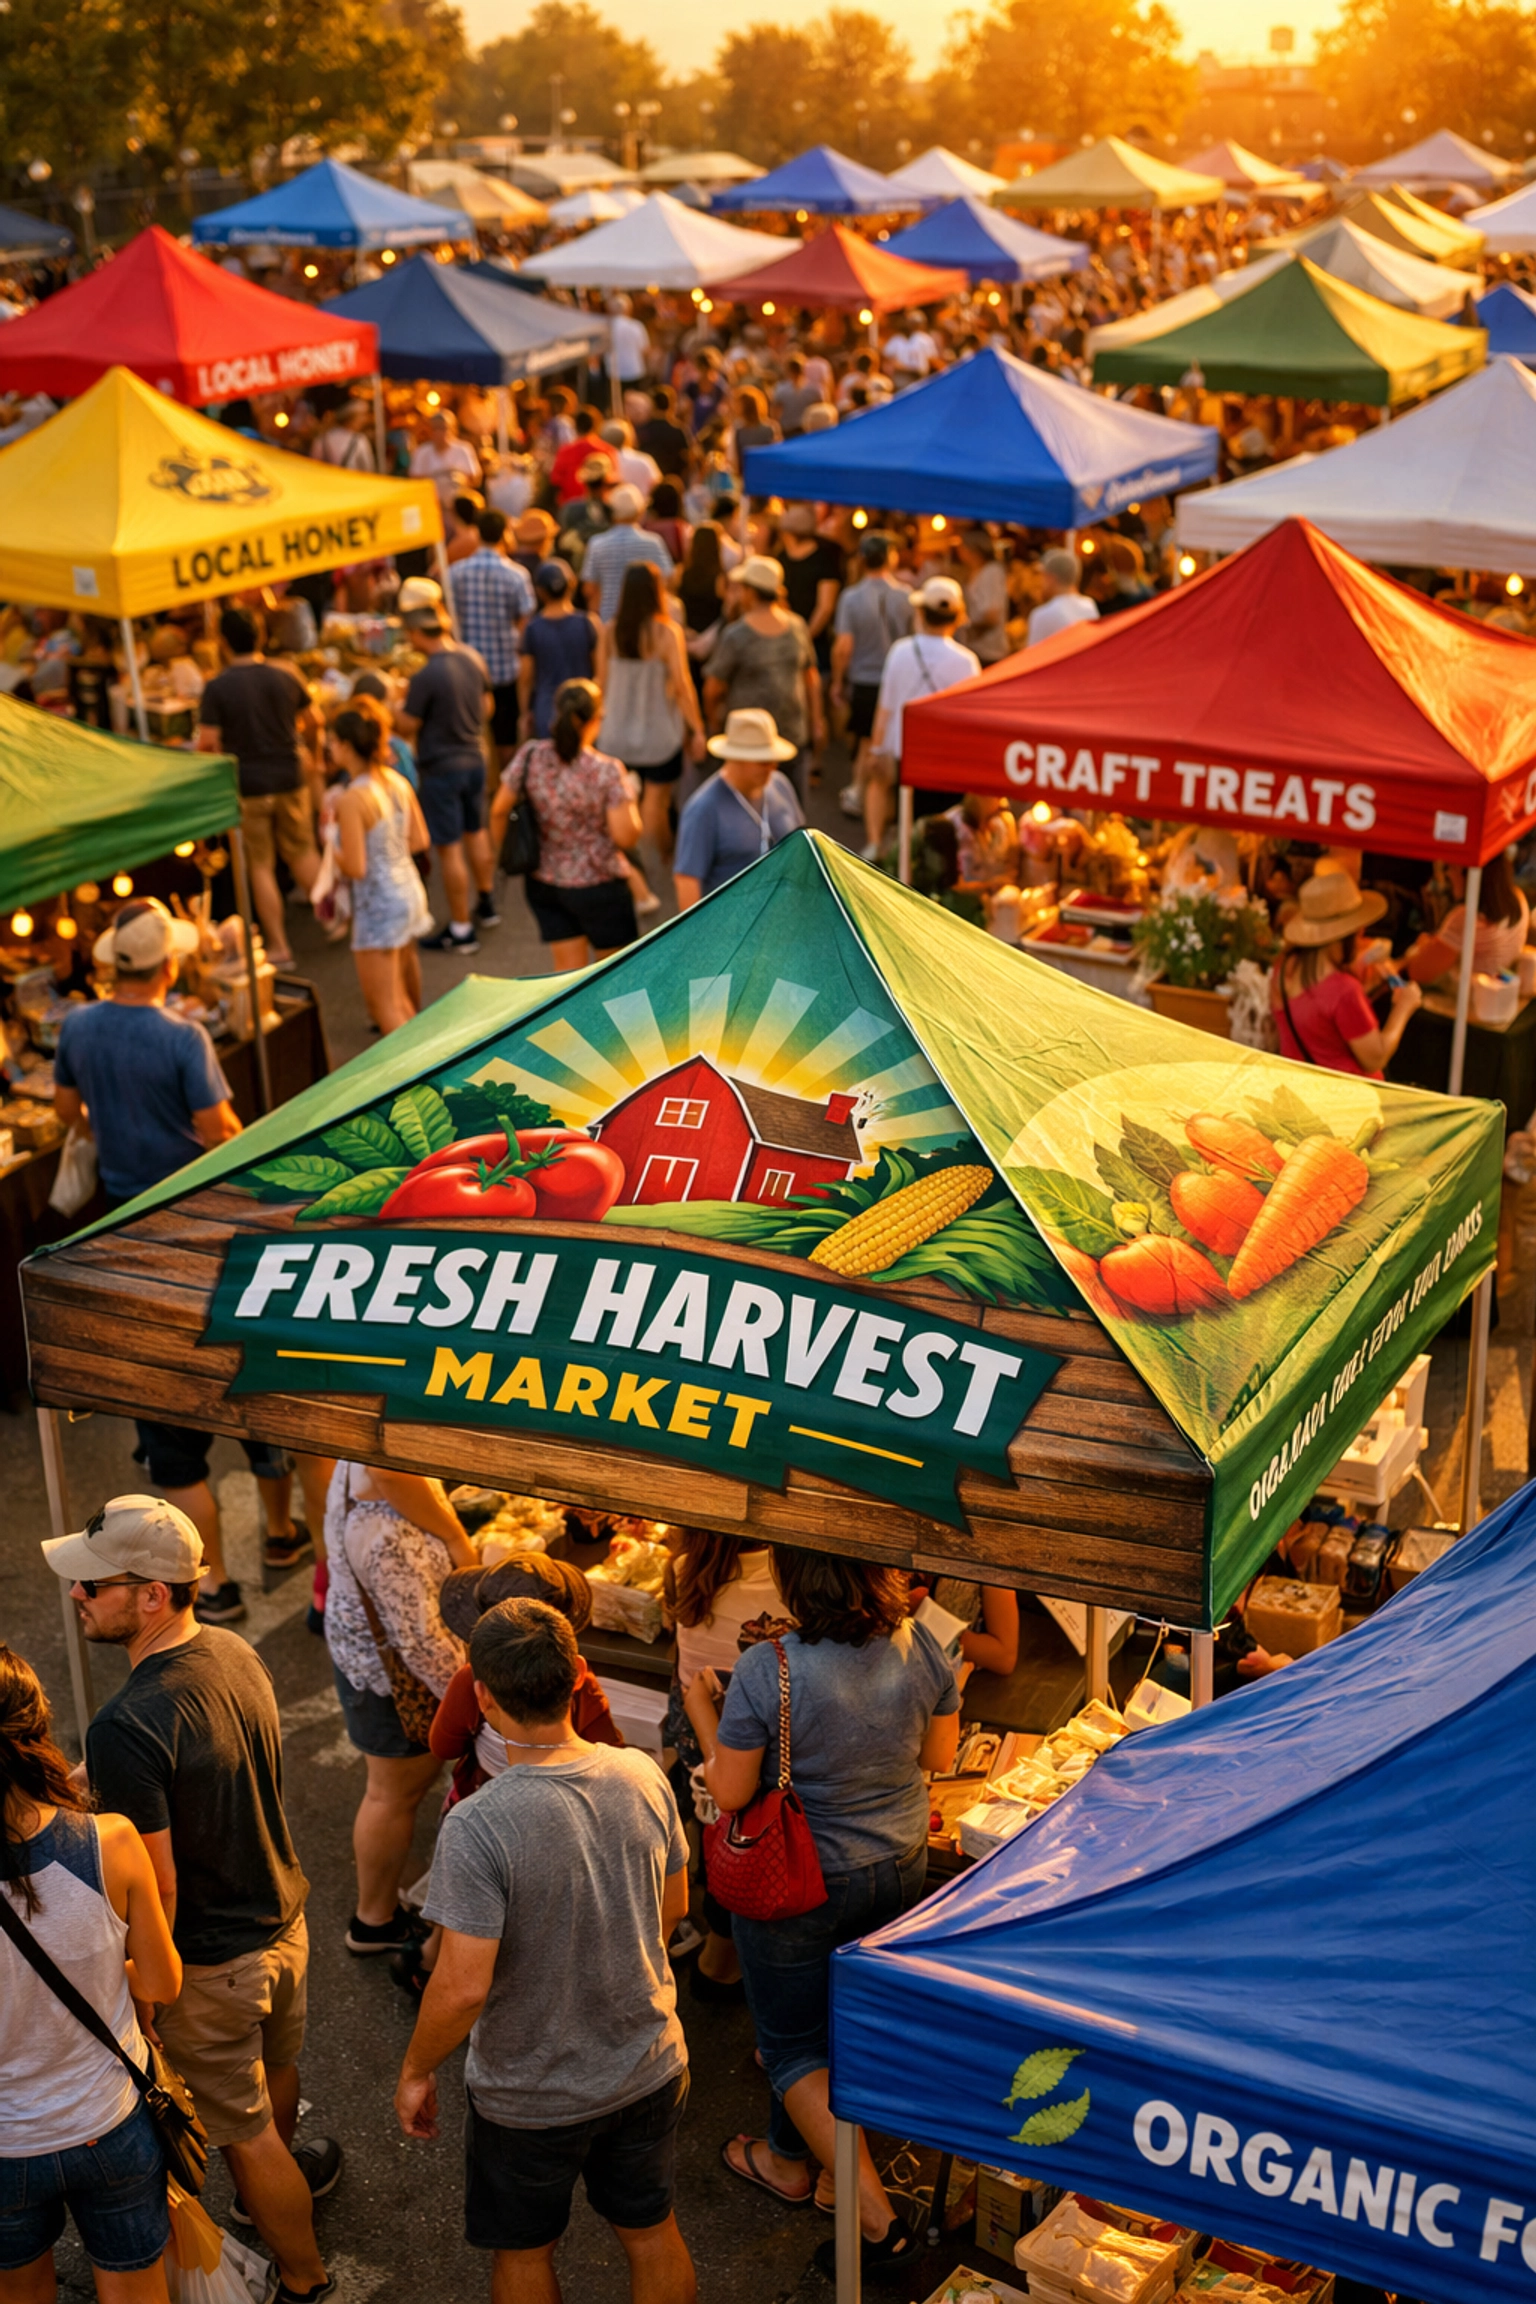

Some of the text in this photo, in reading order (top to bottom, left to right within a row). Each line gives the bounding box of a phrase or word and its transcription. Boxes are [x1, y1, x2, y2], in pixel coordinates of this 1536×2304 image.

[197, 340, 359, 397] LOCAL HONEY
[172, 512, 381, 588] LOCAL HONEY
[1004, 740, 1377, 831] CRAFT TREATS
[234, 1243, 1023, 1437] FRESH HARVEST
[424, 1346, 773, 1449] MARKET
[1132, 2100, 1536, 2273] ORGANIC F
